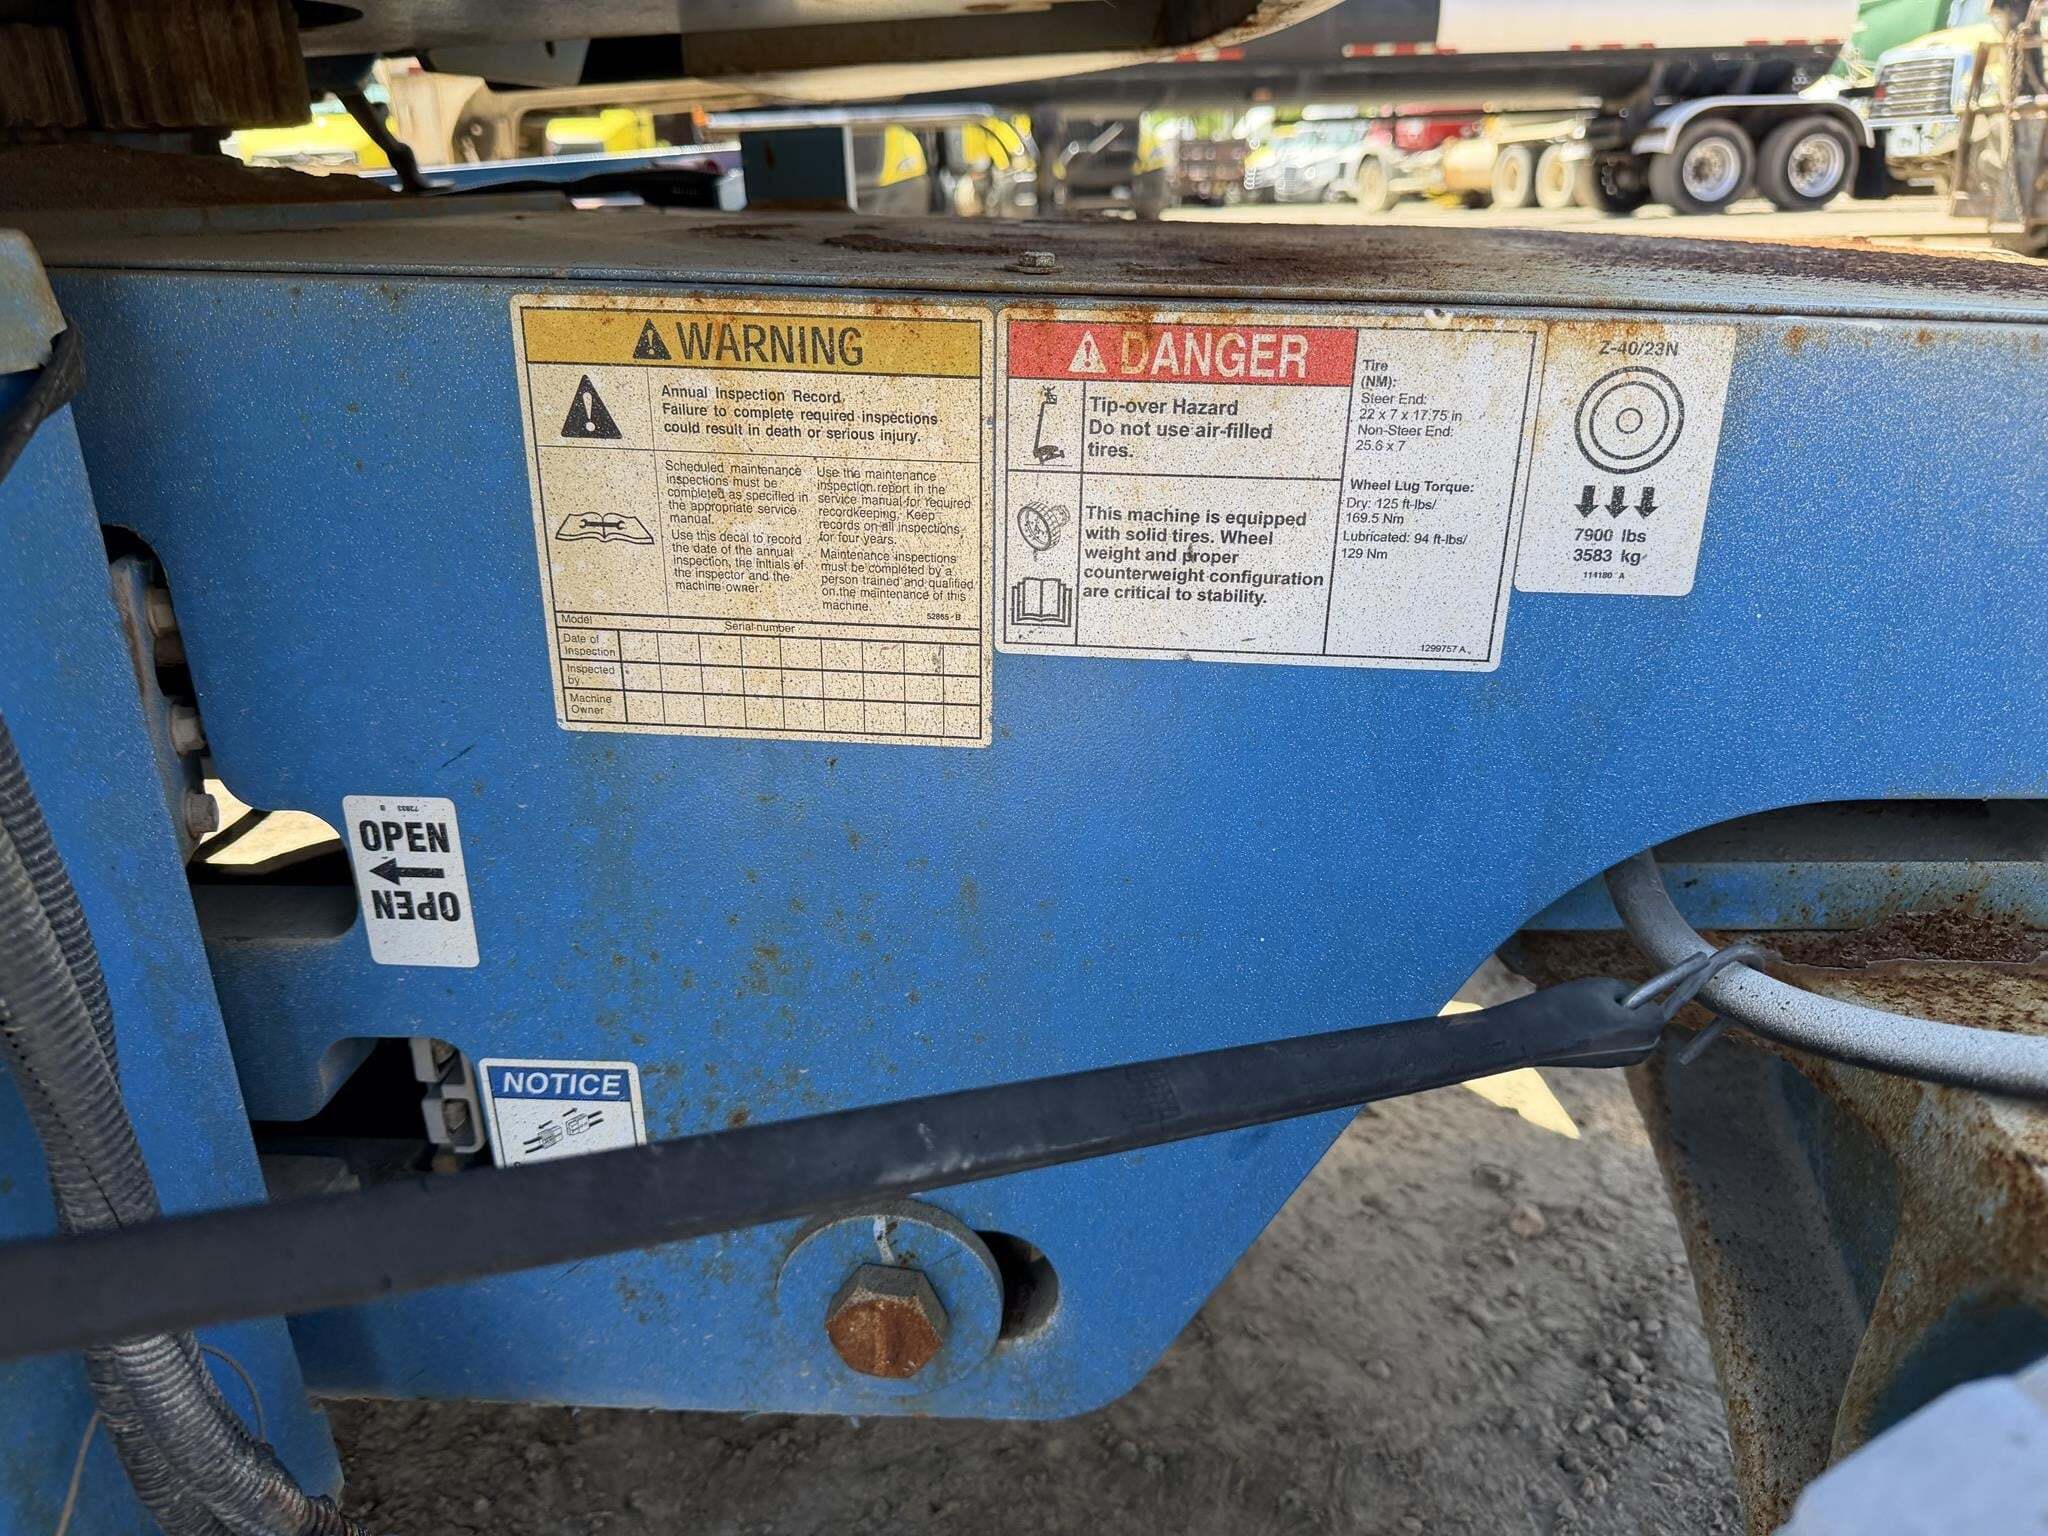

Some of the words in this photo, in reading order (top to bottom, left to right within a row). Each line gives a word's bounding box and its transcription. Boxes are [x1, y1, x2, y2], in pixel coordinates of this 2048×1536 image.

[676, 322, 863, 366] WARNING
[1600, 341, 1678, 357] Z-40/23N
[1120, 330, 1308, 379] DANGER
[1363, 360, 1388, 371] Tire
[1361, 376, 1397, 388] (NM):
[662, 385, 707, 398] Annual
[716, 387, 784, 402] Inspection
[1361, 393, 1394, 404] Steer
[1399, 393, 1427, 405] End:
[1089, 397, 1166, 416] Tip-over
[1173, 400, 1238, 416] Hazard
[663, 403, 707, 416] Failure
[715, 406, 726, 417] to
[734, 408, 793, 420] complete
[801, 409, 854, 423] required
[862, 412, 937, 425] inspections
[1360, 409, 1374, 419] 22
[1415, 410, 1447, 421] 17.75
[1452, 411, 1462, 421] in
[665, 422, 700, 433] could
[706, 424, 743, 435] result
[749, 424, 760, 436] in
[766, 425, 801, 437] death
[808, 428, 820, 438] or
[827, 428, 874, 440] serious
[881, 429, 920, 444] injury.
[1090, 419, 1114, 435] Do
[1121, 421, 1150, 436] not
[1157, 424, 1189, 437] use
[1196, 423, 1272, 439] air-filled
[1358, 425, 1421, 436] Non-Steer
[1426, 426, 1453, 437] End:
[1087, 442, 1134, 458] tires.
[1356, 440, 1382, 450] 25.6
[665, 461, 723, 473] Scheduled
[731, 465, 801, 476] maintenance
[817, 467, 839, 477] Use
[844, 468, 860, 478] the
[865, 470, 936, 481] maintenance
[667, 475, 728, 486] inspections
[733, 478, 759, 487] must
[764, 479, 777, 487] be
[817, 481, 873, 492] inspection
[878, 484, 910, 494] report
[915, 484, 923, 493] in
[928, 485, 945, 494] the
[1351, 479, 1390, 490] Wheel
[1395, 481, 1419, 493] Lug
[1424, 481, 1474, 494] Torque:
[668, 488, 724, 499] completed
[746, 491, 794, 503] specified
[799, 492, 808, 502] in
[818, 495, 858, 504] service
[862, 495, 902, 506] manual
[907, 497, 921, 506] for
[926, 498, 970, 509] required
[669, 501, 685, 510] the
[691, 502, 752, 513] appropriate
[758, 506, 797, 515] service
[1346, 498, 1371, 510] Dry:
[1377, 499, 1398, 509] 125
[1402, 499, 1437, 510] ft-lbs/
[670, 514, 714, 524] manual.
[907, 509, 935, 522] Keep
[1086, 506, 1122, 520] This
[1128, 508, 1200, 525] machine
[1206, 510, 1219, 523] is
[1226, 512, 1306, 528] equipped
[1346, 513, 1379, 523] 169.5
[1383, 514, 1404, 524] Nm
[819, 520, 860, 530] records
[864, 523, 877, 531] on
[882, 522, 894, 532] all
[899, 523, 959, 534] inspections
[671, 530, 693, 540] Use
[697, 531, 716, 541] this
[720, 531, 749, 542] decal
[753, 534, 763, 543] to
[768, 534, 801, 544] record
[819, 532, 834, 541] for
[838, 533, 859, 542] four
[863, 535, 896, 545] years.
[1086, 527, 1120, 540] with
[1126, 528, 1167, 542] solid
[1172, 530, 1214, 544] tires.
[1221, 530, 1273, 545] Wheel
[1343, 531, 1410, 542] Lubricated:
[1414, 533, 1428, 543] 94
[1434, 534, 1468, 544] ft-lbs/
[1575, 528, 1613, 541] 7900
[1621, 529, 1646, 543] lbs
[673, 543, 689, 552] the
[694, 544, 717, 553] date
[721, 545, 731, 554] of
[735, 545, 752, 555] the
[756, 547, 793, 556] annual
[820, 549, 889, 560] Maintenance
[895, 553, 956, 564] inspections
[1085, 547, 1146, 564] weight
[1146, 549, 1176, 562] and
[1183, 550, 1239, 566] proper
[1342, 549, 1362, 558] 129
[1367, 549, 1388, 559] Nm
[673, 556, 731, 568] inspection,
[736, 559, 752, 567] the
[756, 559, 790, 569] initials
[794, 560, 804, 570] of
[1573, 549, 1612, 562] 3583
[1621, 551, 1641, 565] kg
[675, 568, 691, 577] the
[695, 570, 744, 580] inspector
[749, 572, 768, 581] and
[773, 572, 789, 581] the
[821, 563, 847, 572] must
[852, 563, 864, 572] be
[869, 563, 924, 575] completed
[929, 565, 941, 577] by
[1084, 567, 1204, 584] counterweight
[1210, 570, 1324, 587] configuration
[676, 581, 720, 591] machine
[821, 575, 858, 586] person
[863, 576, 899, 586] trained
[905, 577, 924, 588] and
[929, 578, 973, 591] qualified
[822, 588, 835, 596] on
[839, 586, 855, 596] the
[861, 589, 929, 600] maintenance
[933, 591, 944, 600] of
[947, 590, 966, 601] this
[1083, 587, 1109, 598] are
[1114, 586, 1170, 600] critical
[1176, 589, 1192, 601] to
[1197, 589, 1266, 607] stability.
[823, 600, 871, 611] machine.
[561, 615, 592, 624] Model
[725, 621, 752, 630] Serial
[756, 624, 794, 633] number
[564, 634, 586, 643] Date
[590, 635, 599, 643] of
[565, 647, 615, 658] Inspection
[1420, 645, 1457, 653] 1299757
[567, 664, 615, 675] Inspected
[568, 676, 579, 686] by
[570, 694, 611, 703] Machine
[572, 705, 604, 714] Owner
[359, 820, 451, 853] OPEN
[371, 890, 460, 921] OPEN
[503, 1072, 621, 1095] NOTICE
